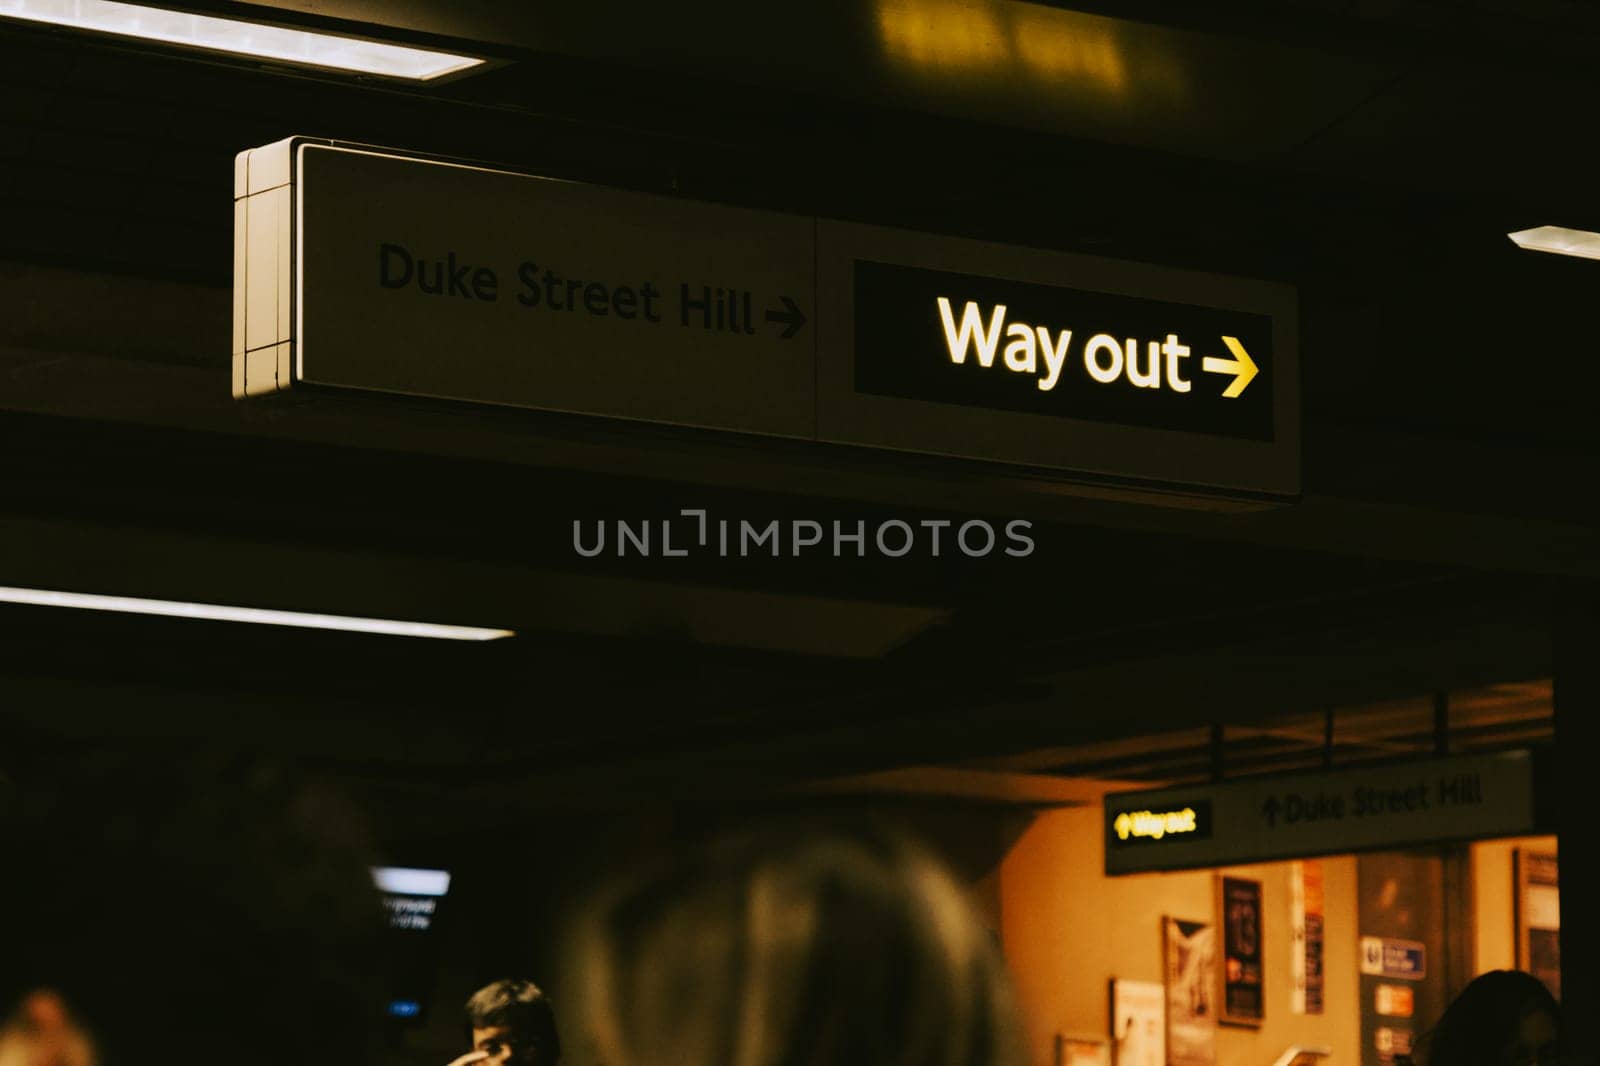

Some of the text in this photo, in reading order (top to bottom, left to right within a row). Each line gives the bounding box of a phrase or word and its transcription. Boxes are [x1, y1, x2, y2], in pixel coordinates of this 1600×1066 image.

[379, 242, 756, 335] Duke Street Hill
[937, 296, 1193, 393] Way out
[1285, 773, 1483, 823] Duke Street Hill
